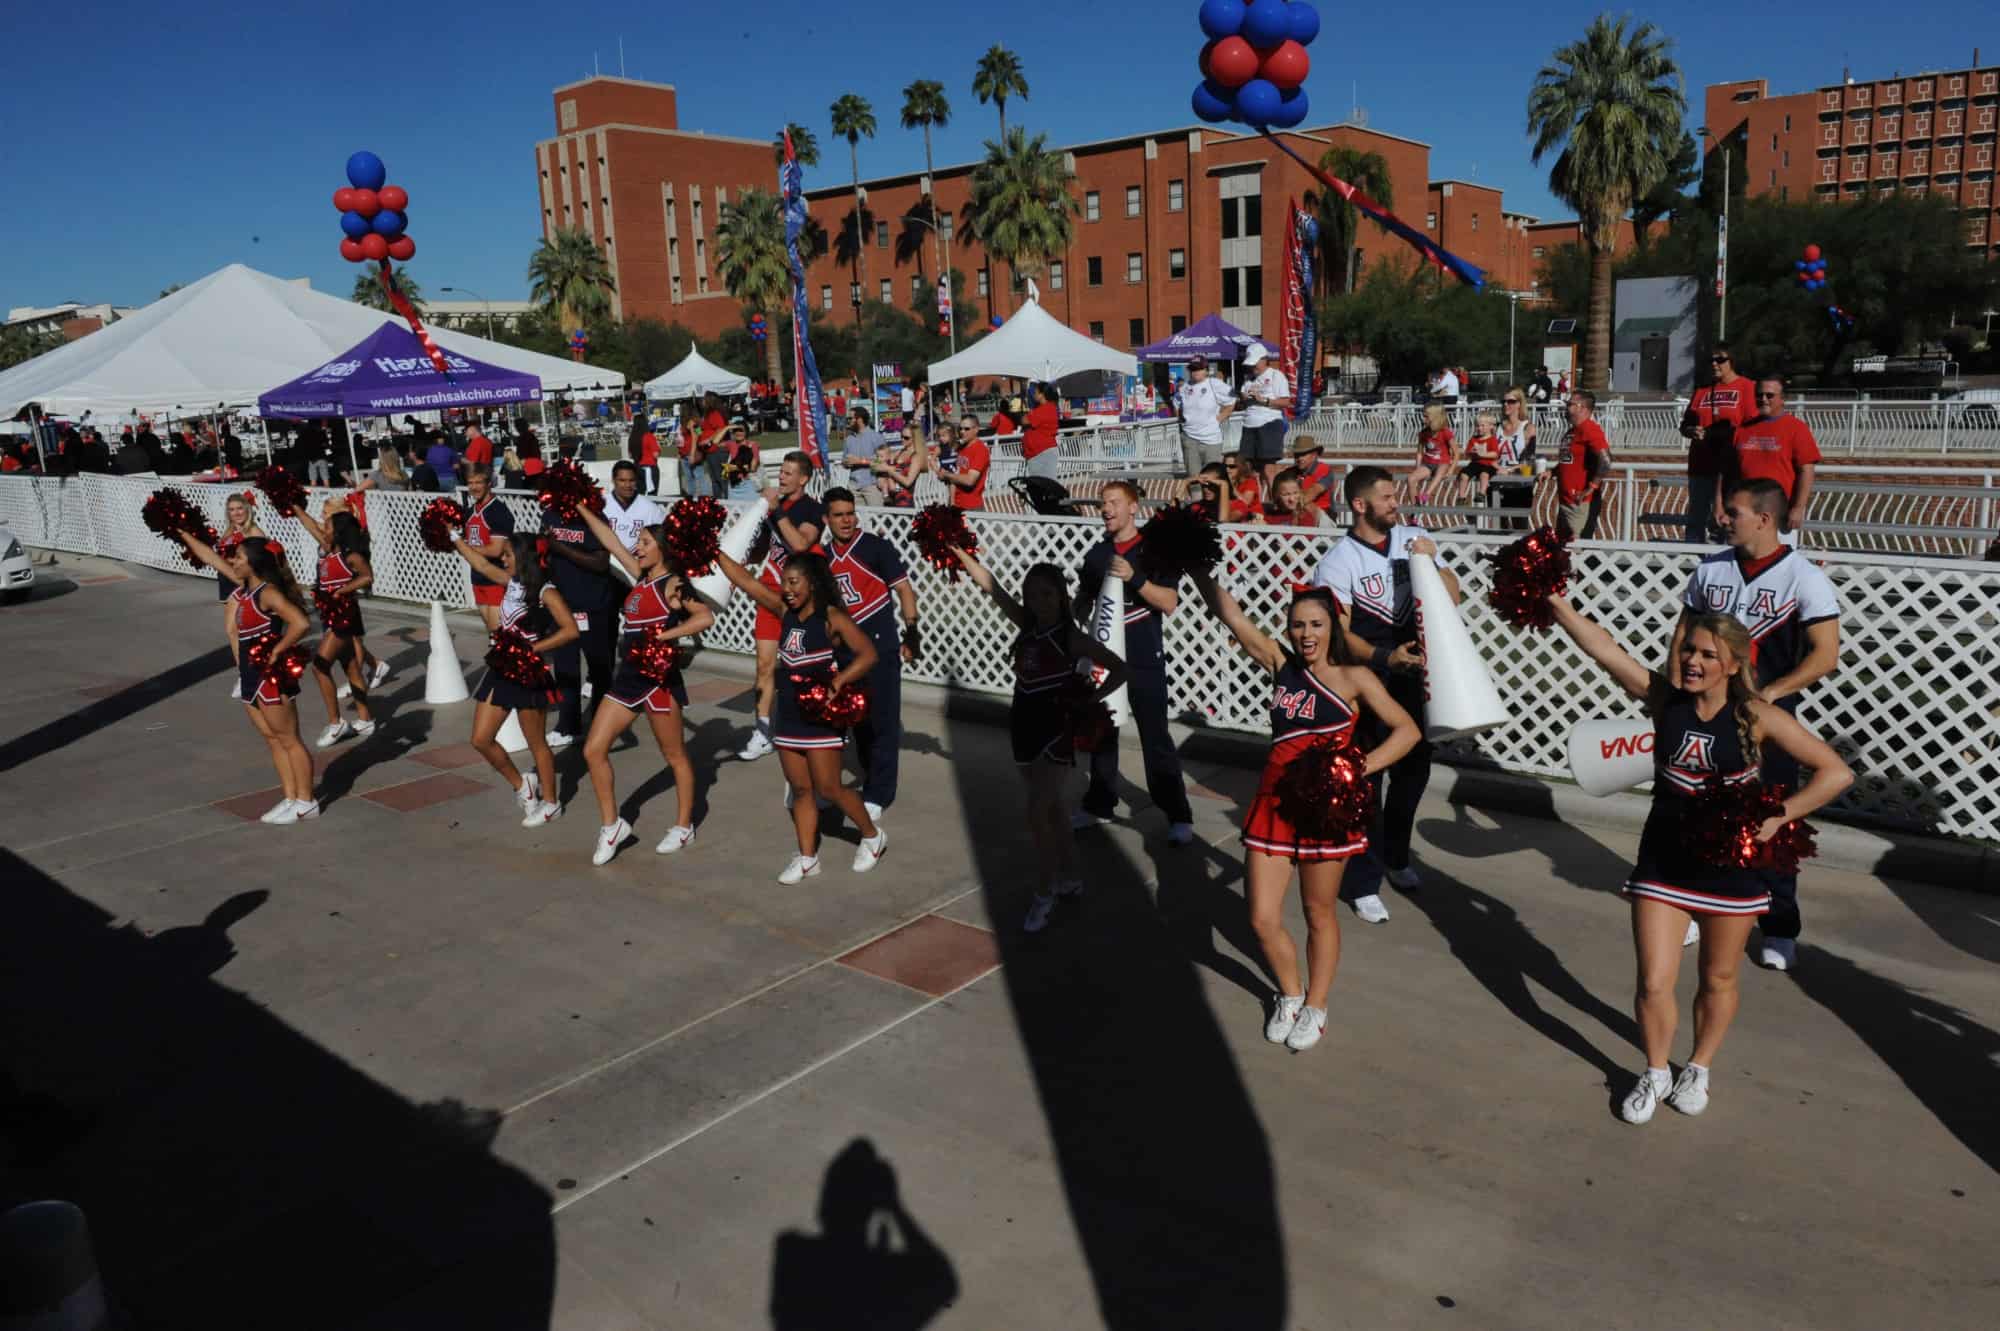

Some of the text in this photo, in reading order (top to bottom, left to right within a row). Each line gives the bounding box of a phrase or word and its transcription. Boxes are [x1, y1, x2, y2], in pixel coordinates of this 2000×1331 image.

[876, 365, 895, 377] WIN
[370, 386, 521, 408] www.harrahsakchin.com
[1360, 573, 1385, 599] U
[1707, 584, 1733, 613] U
[1746, 588, 1777, 621] A
[783, 628, 806, 656] A
[1669, 730, 1718, 773] A
